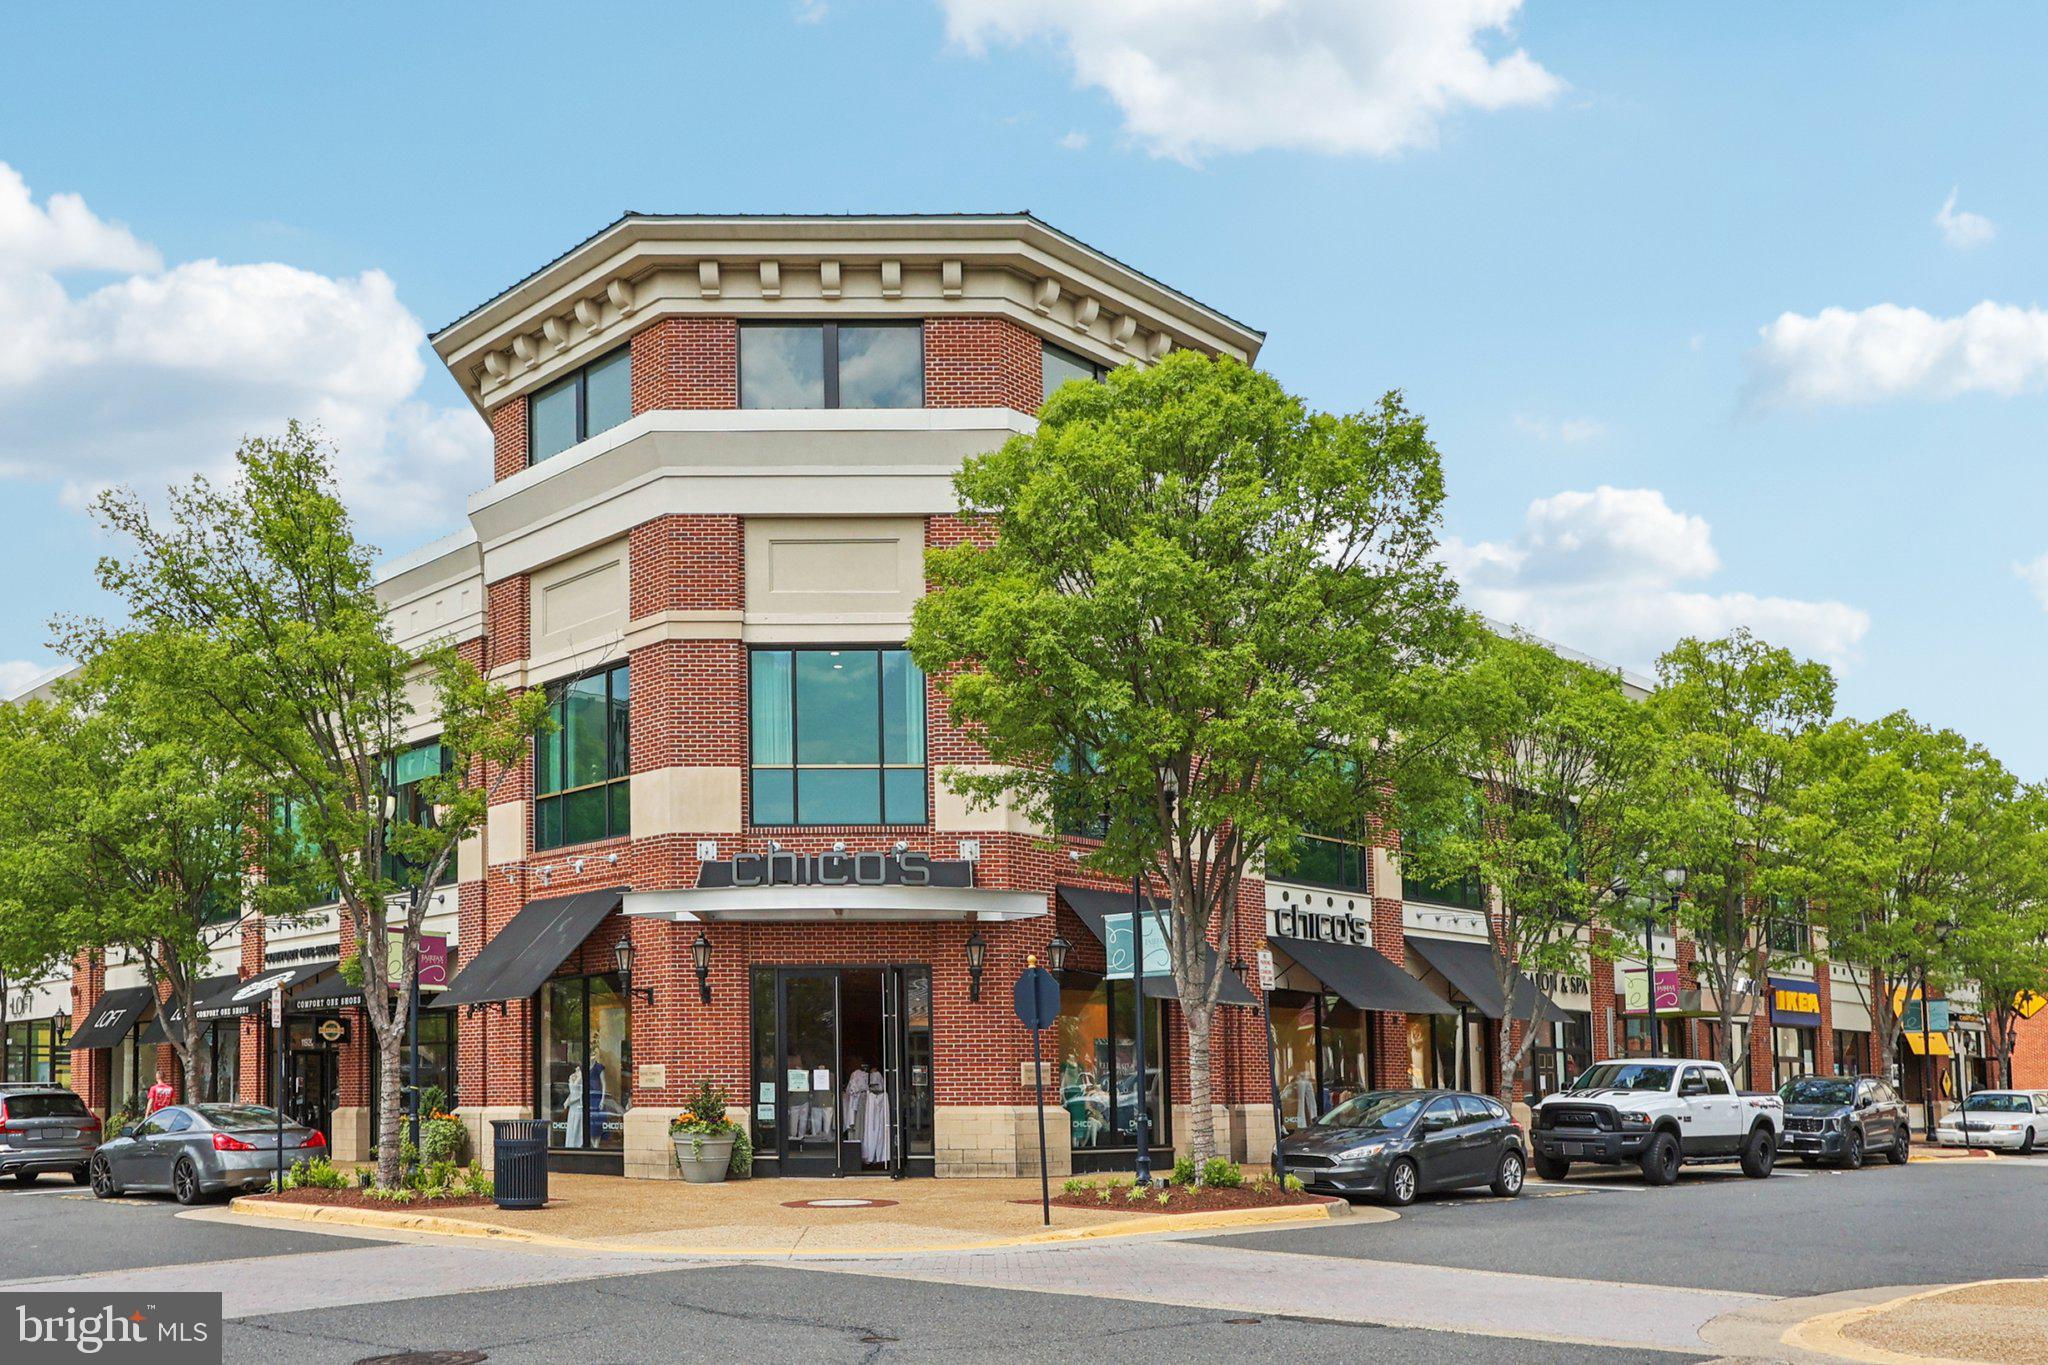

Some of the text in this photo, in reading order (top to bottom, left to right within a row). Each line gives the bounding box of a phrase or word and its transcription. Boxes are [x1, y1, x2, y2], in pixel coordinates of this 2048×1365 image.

[1561, 976, 1568, 993] &
[1570, 977, 1589, 995] SPA
[11, 995, 34, 1016] LOFT
[1775, 990, 1821, 1014] IKEA
[94, 1009, 127, 1029] LOFT
